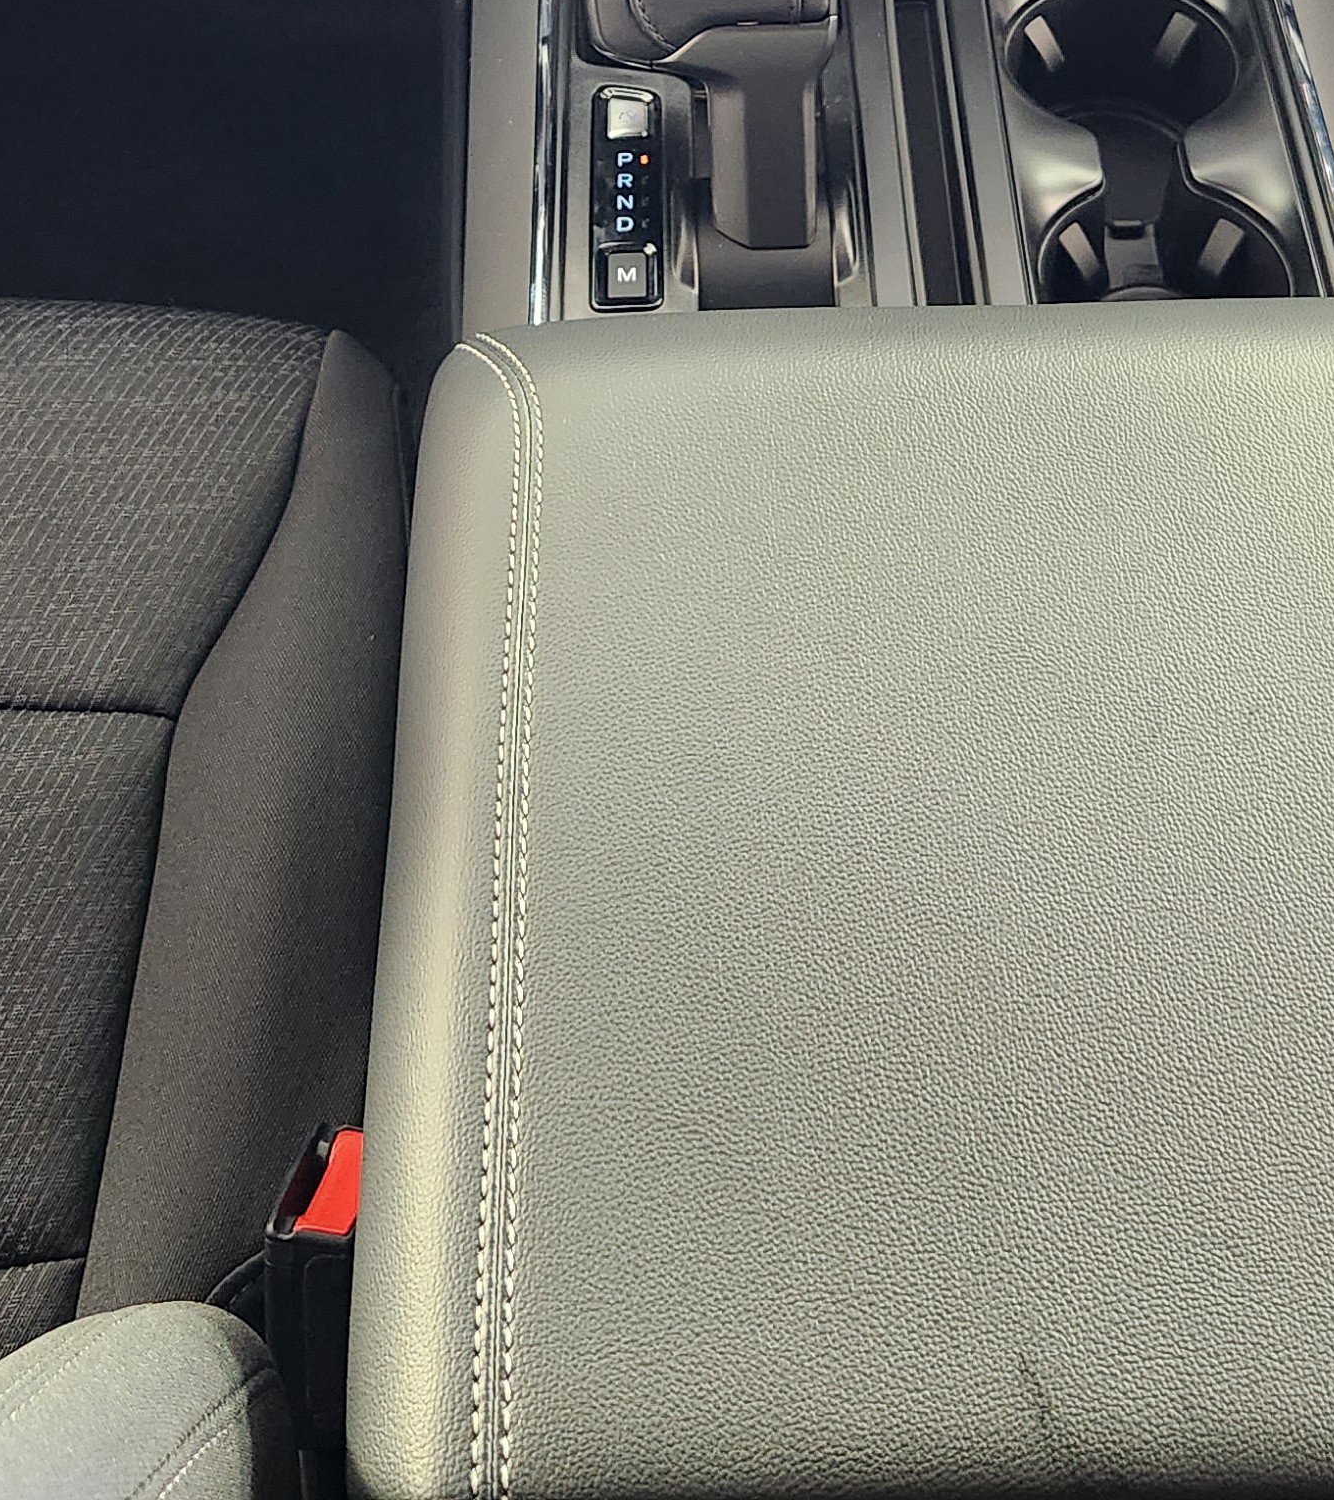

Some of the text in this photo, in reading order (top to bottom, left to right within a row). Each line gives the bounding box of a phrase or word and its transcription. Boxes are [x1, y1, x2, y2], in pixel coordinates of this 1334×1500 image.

[617, 152, 634, 168] P
[617, 173, 633, 188] R
[616, 194, 634, 210] N
[616, 216, 634, 232] D
[616, 266, 637, 282] M
